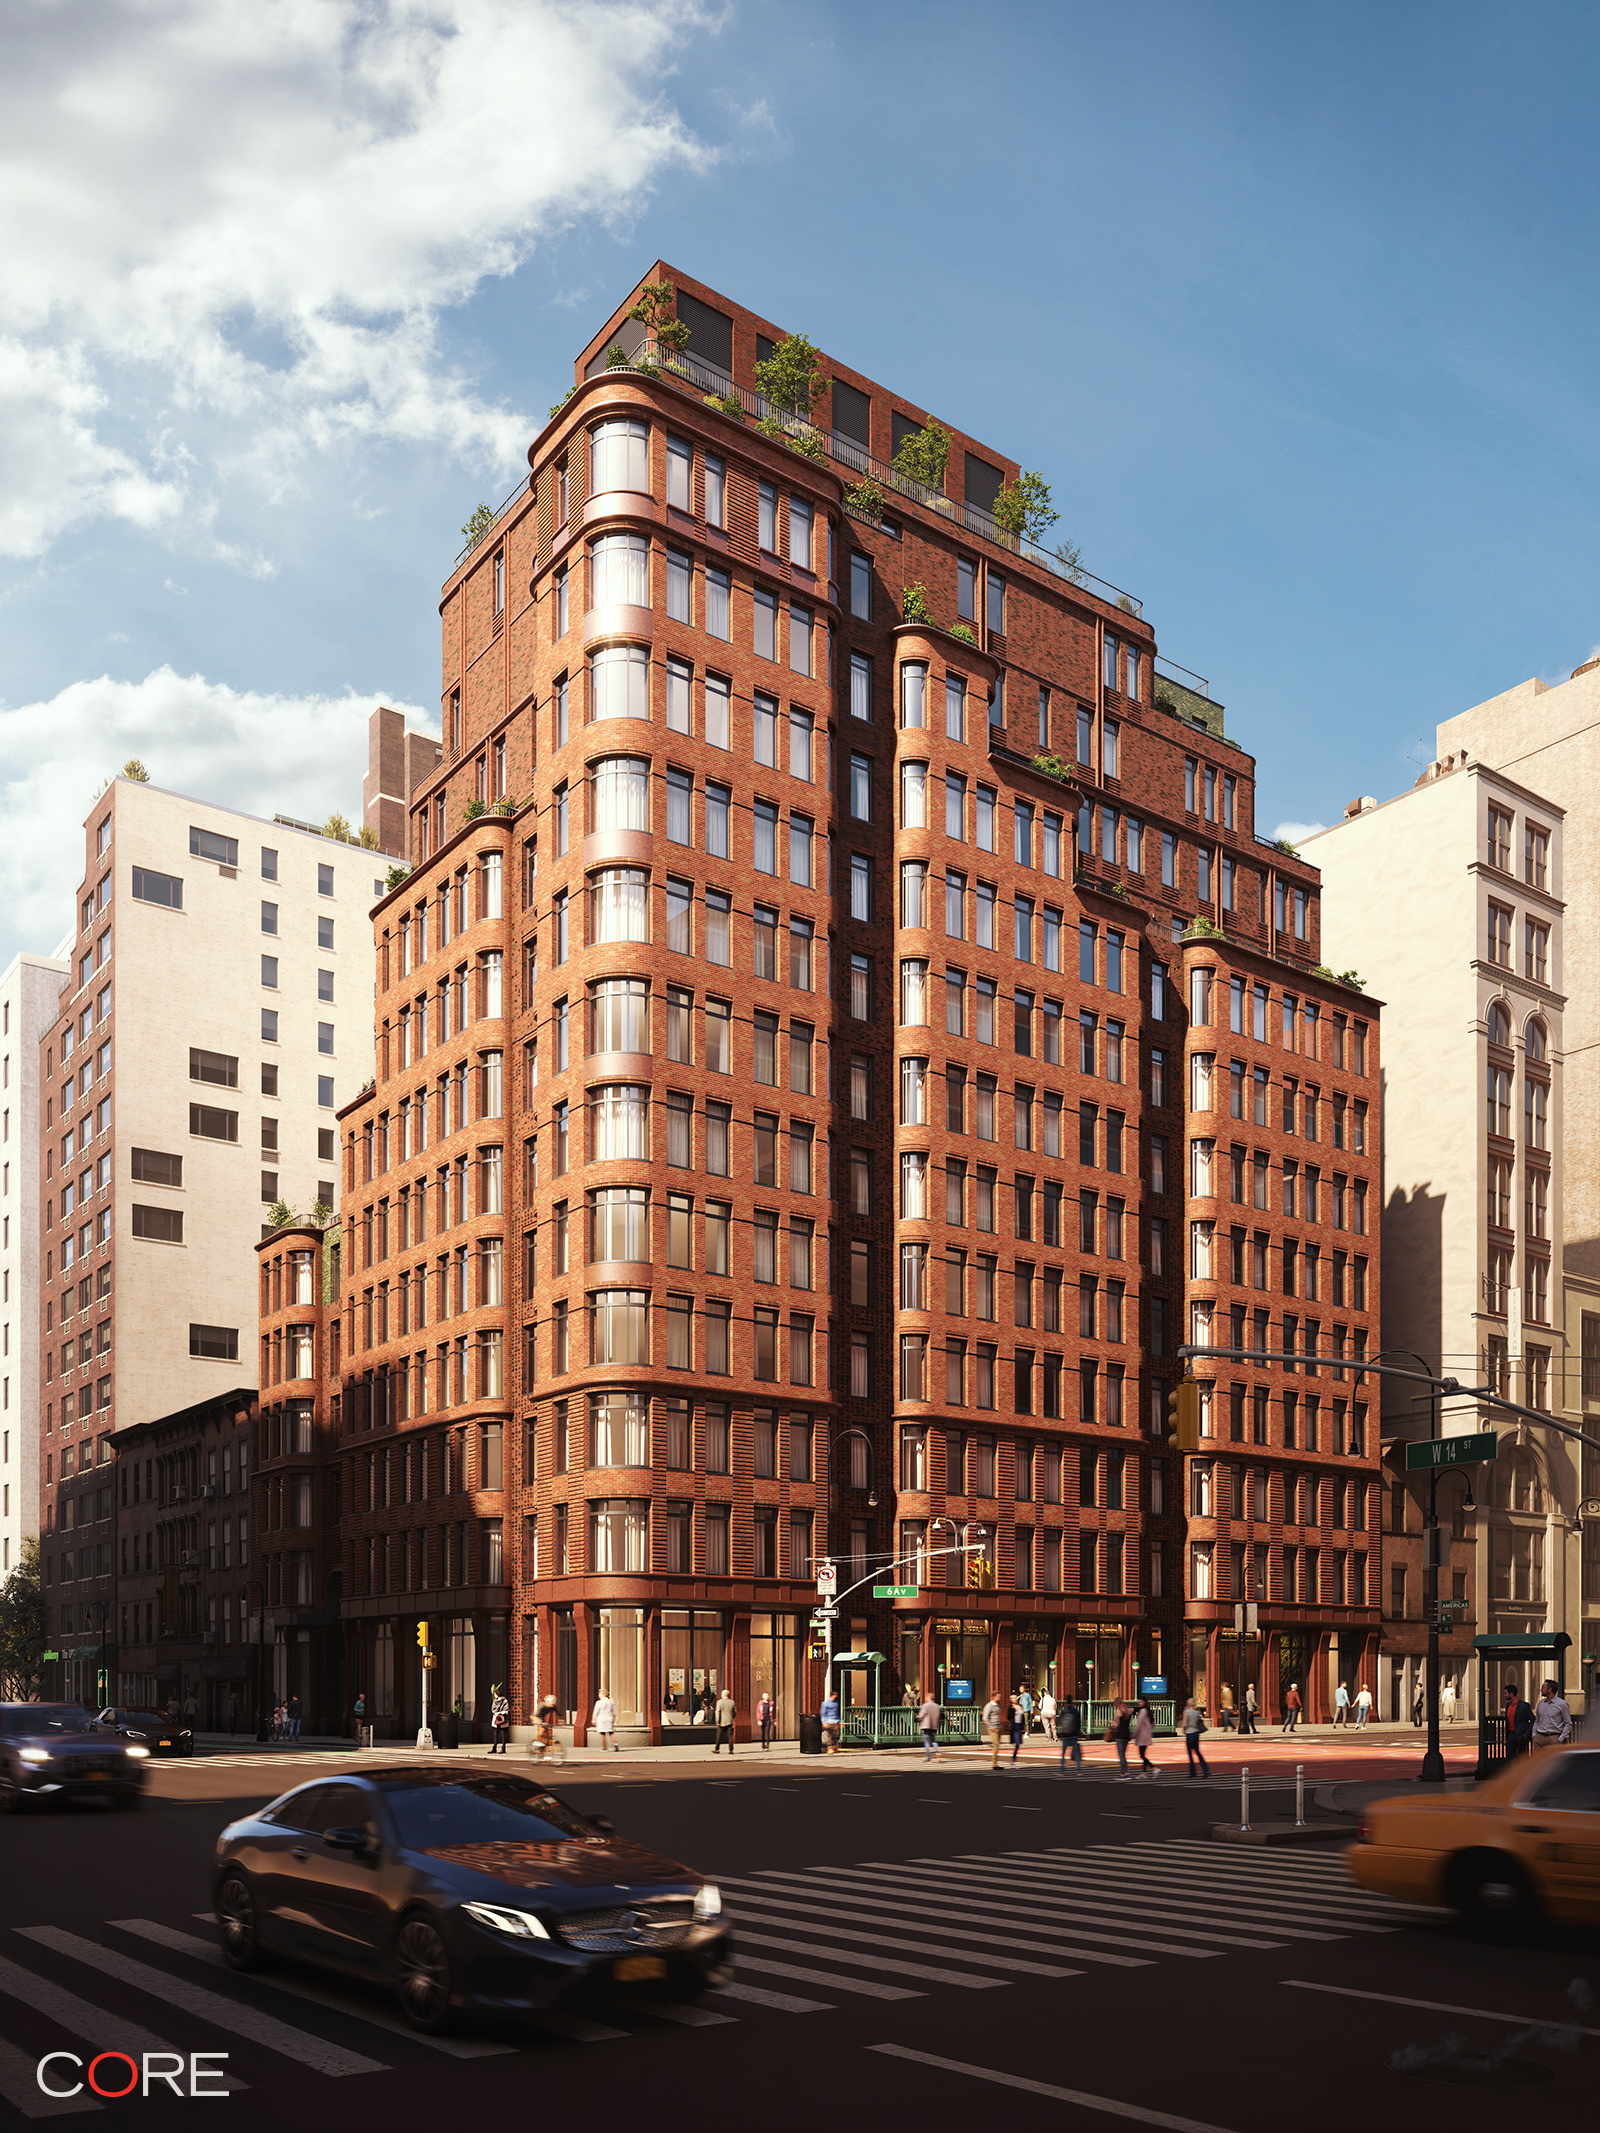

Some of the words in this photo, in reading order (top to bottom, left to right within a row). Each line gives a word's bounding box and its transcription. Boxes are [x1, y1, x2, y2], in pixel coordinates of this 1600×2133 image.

[1432, 1443, 1442, 1463] W
[1446, 1441, 1456, 1462] 14
[1463, 1439, 1472, 1449] ST
[1016, 1632, 1050, 1642] BOTANY
